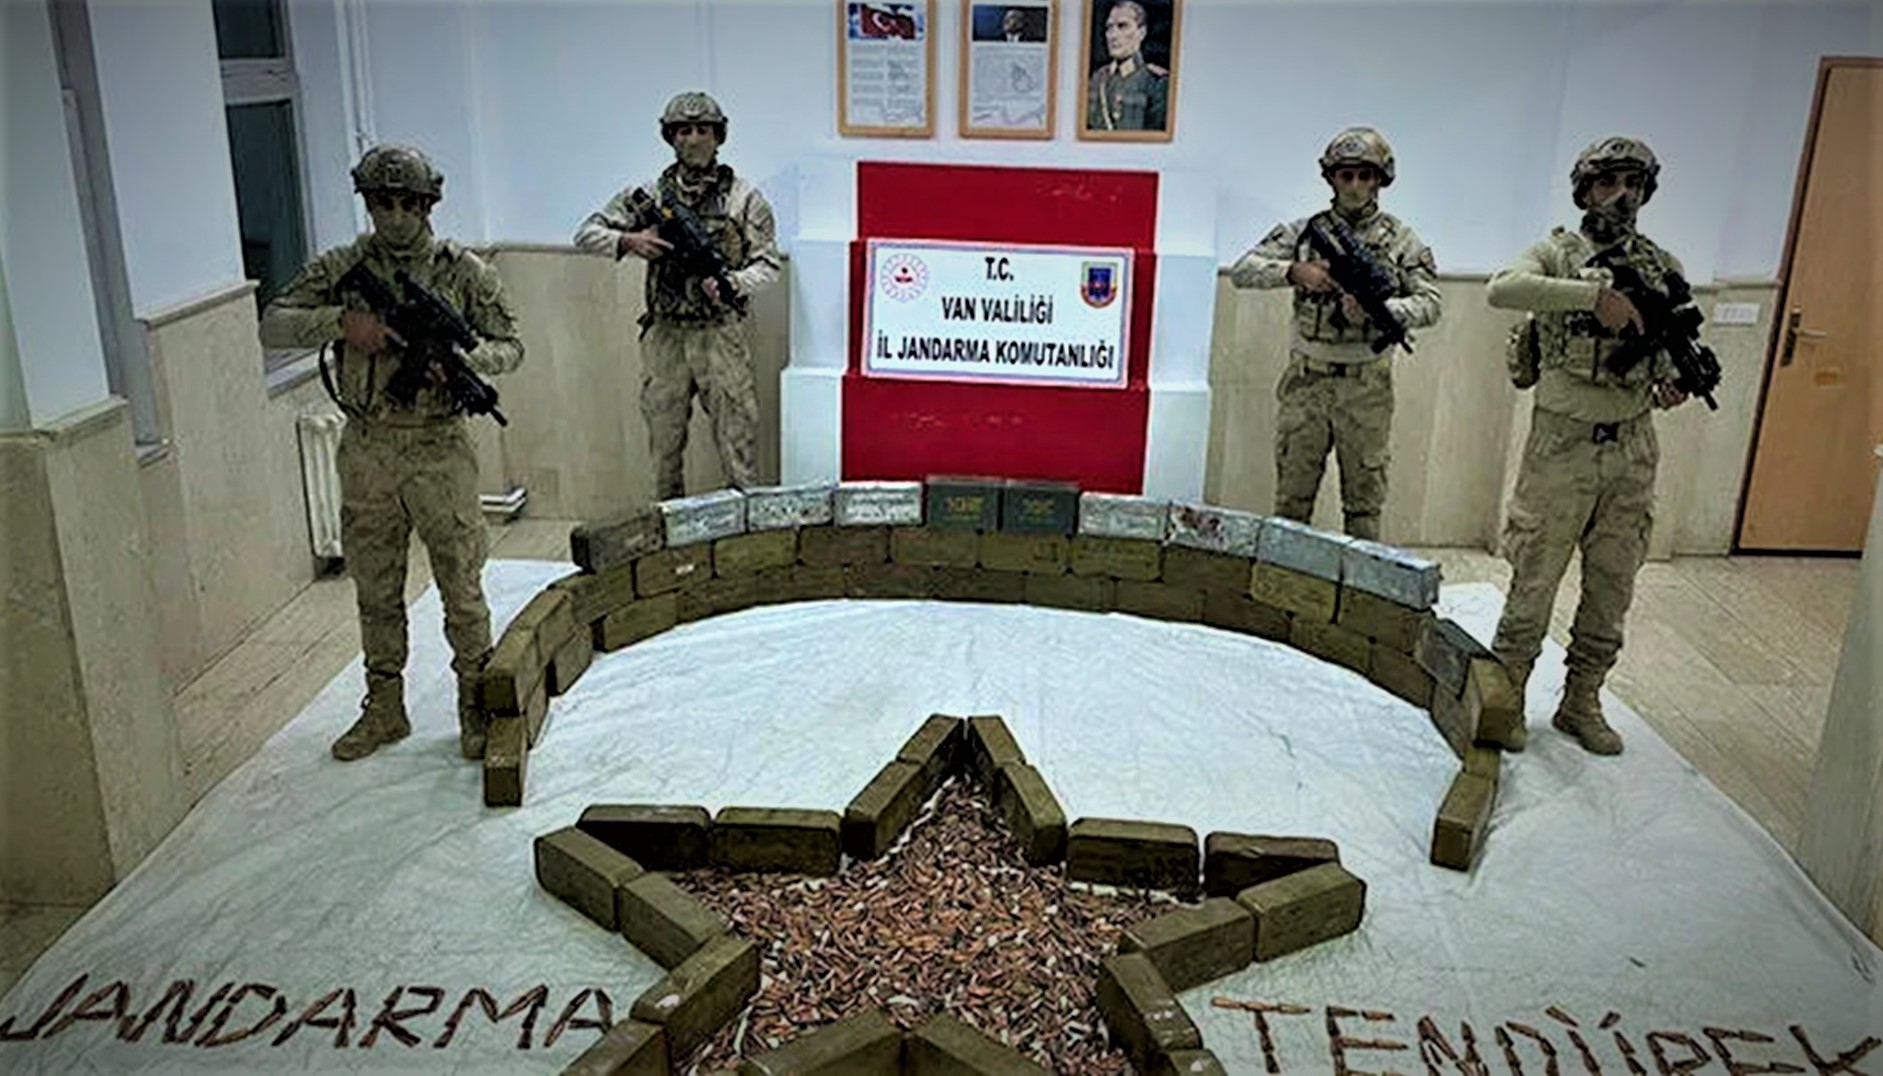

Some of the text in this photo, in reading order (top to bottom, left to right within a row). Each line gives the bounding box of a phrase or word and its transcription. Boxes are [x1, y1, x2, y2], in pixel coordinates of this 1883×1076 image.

[985, 257, 1014, 281] T.C.
[941, 294, 1054, 325] VAN VALİLİĞİ
[876, 329, 1115, 369] İL JANDARMA KOMUTANLIĞI
[0, 973, 614, 1050] JANDARMA
